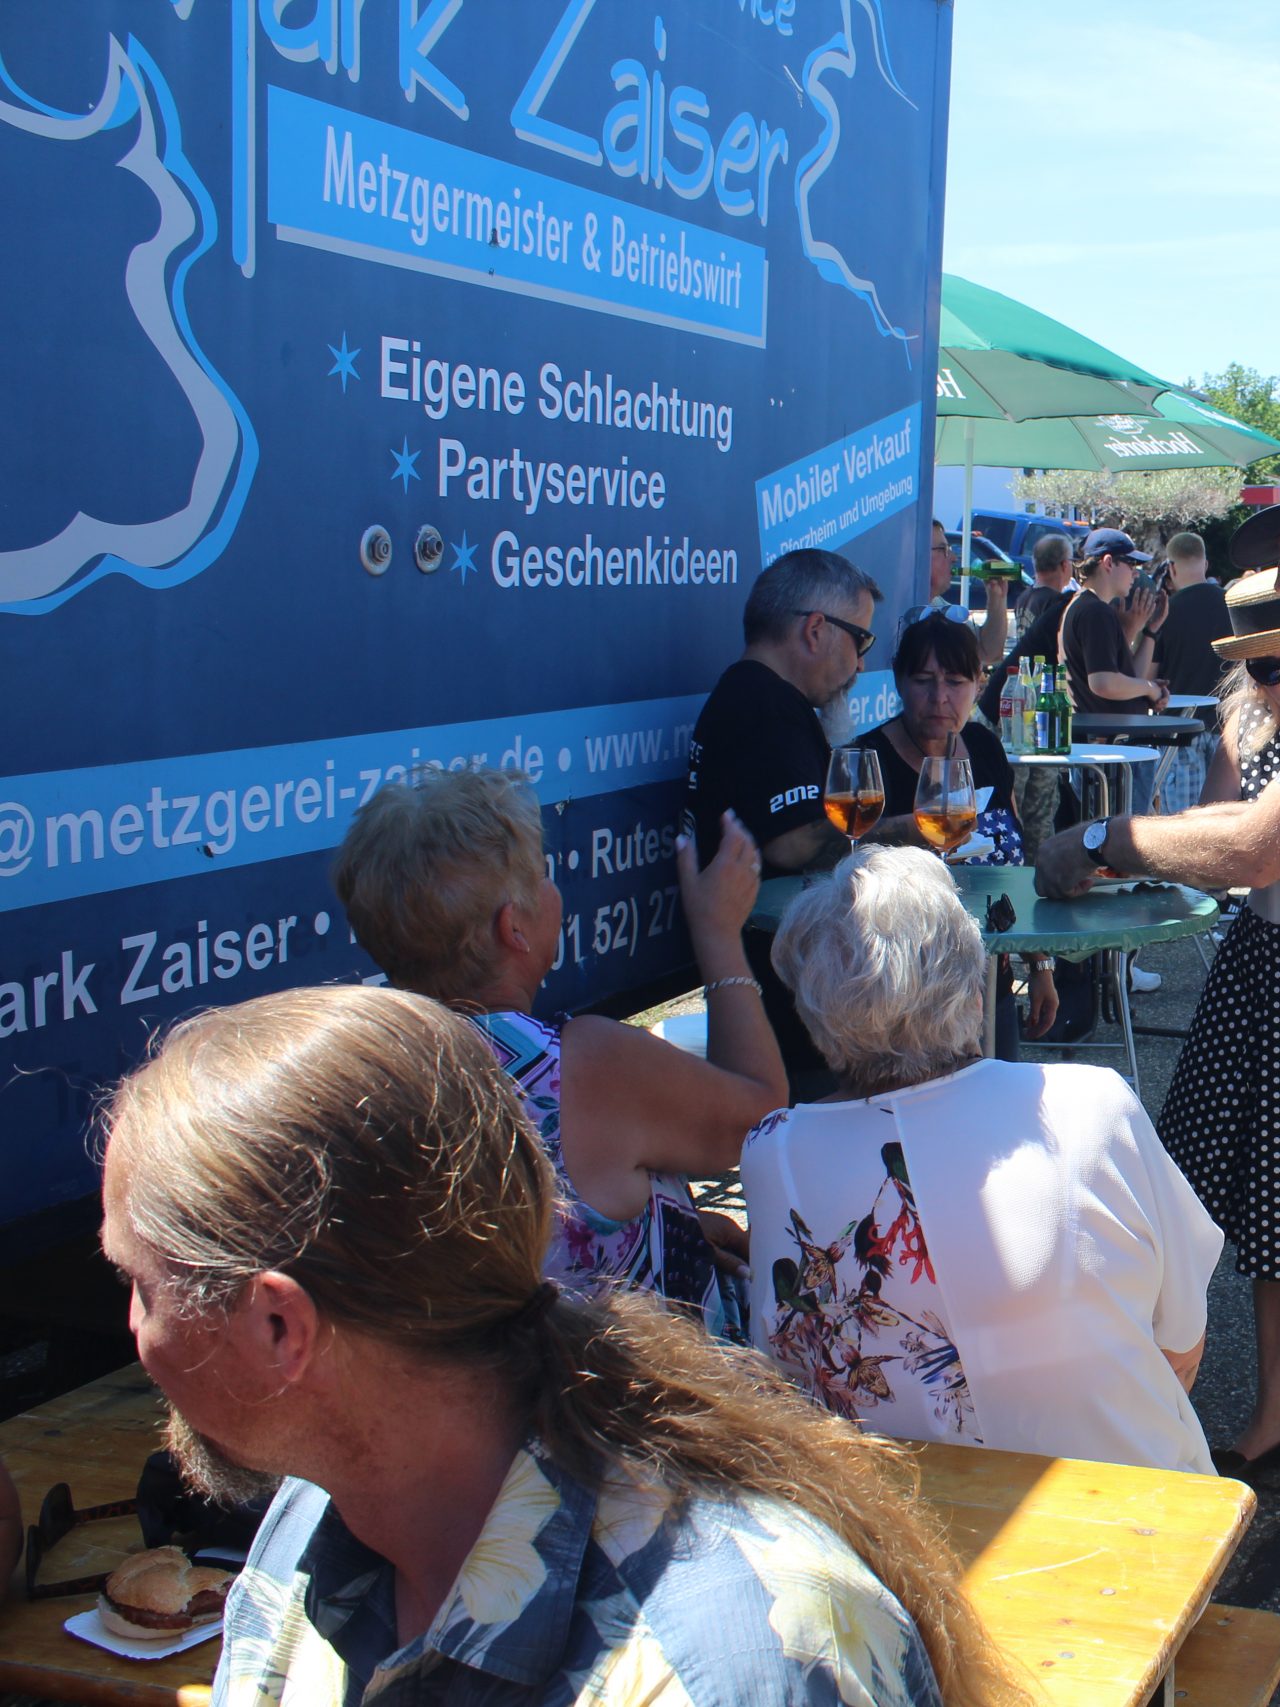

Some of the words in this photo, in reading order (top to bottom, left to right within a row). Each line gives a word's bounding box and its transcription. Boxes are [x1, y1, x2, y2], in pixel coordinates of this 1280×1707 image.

[322, 125, 573, 264] Metzgermeister
[582, 212, 602, 273] &
[611, 215, 742, 308] Betriebswirt
[380, 335, 526, 420] Eigene
[538, 362, 733, 453] Schlachtung
[438, 437, 666, 515] Partyservice
[761, 463, 841, 530] Mobiler
[843, 418, 912, 484] Verkauf
[839, 501, 860, 530] und
[861, 475, 913, 518] Umgebung
[491, 530, 738, 588] Geschenkideen
[120, 915, 298, 1005] Zaiser
[591, 821, 677, 879] Rutes
